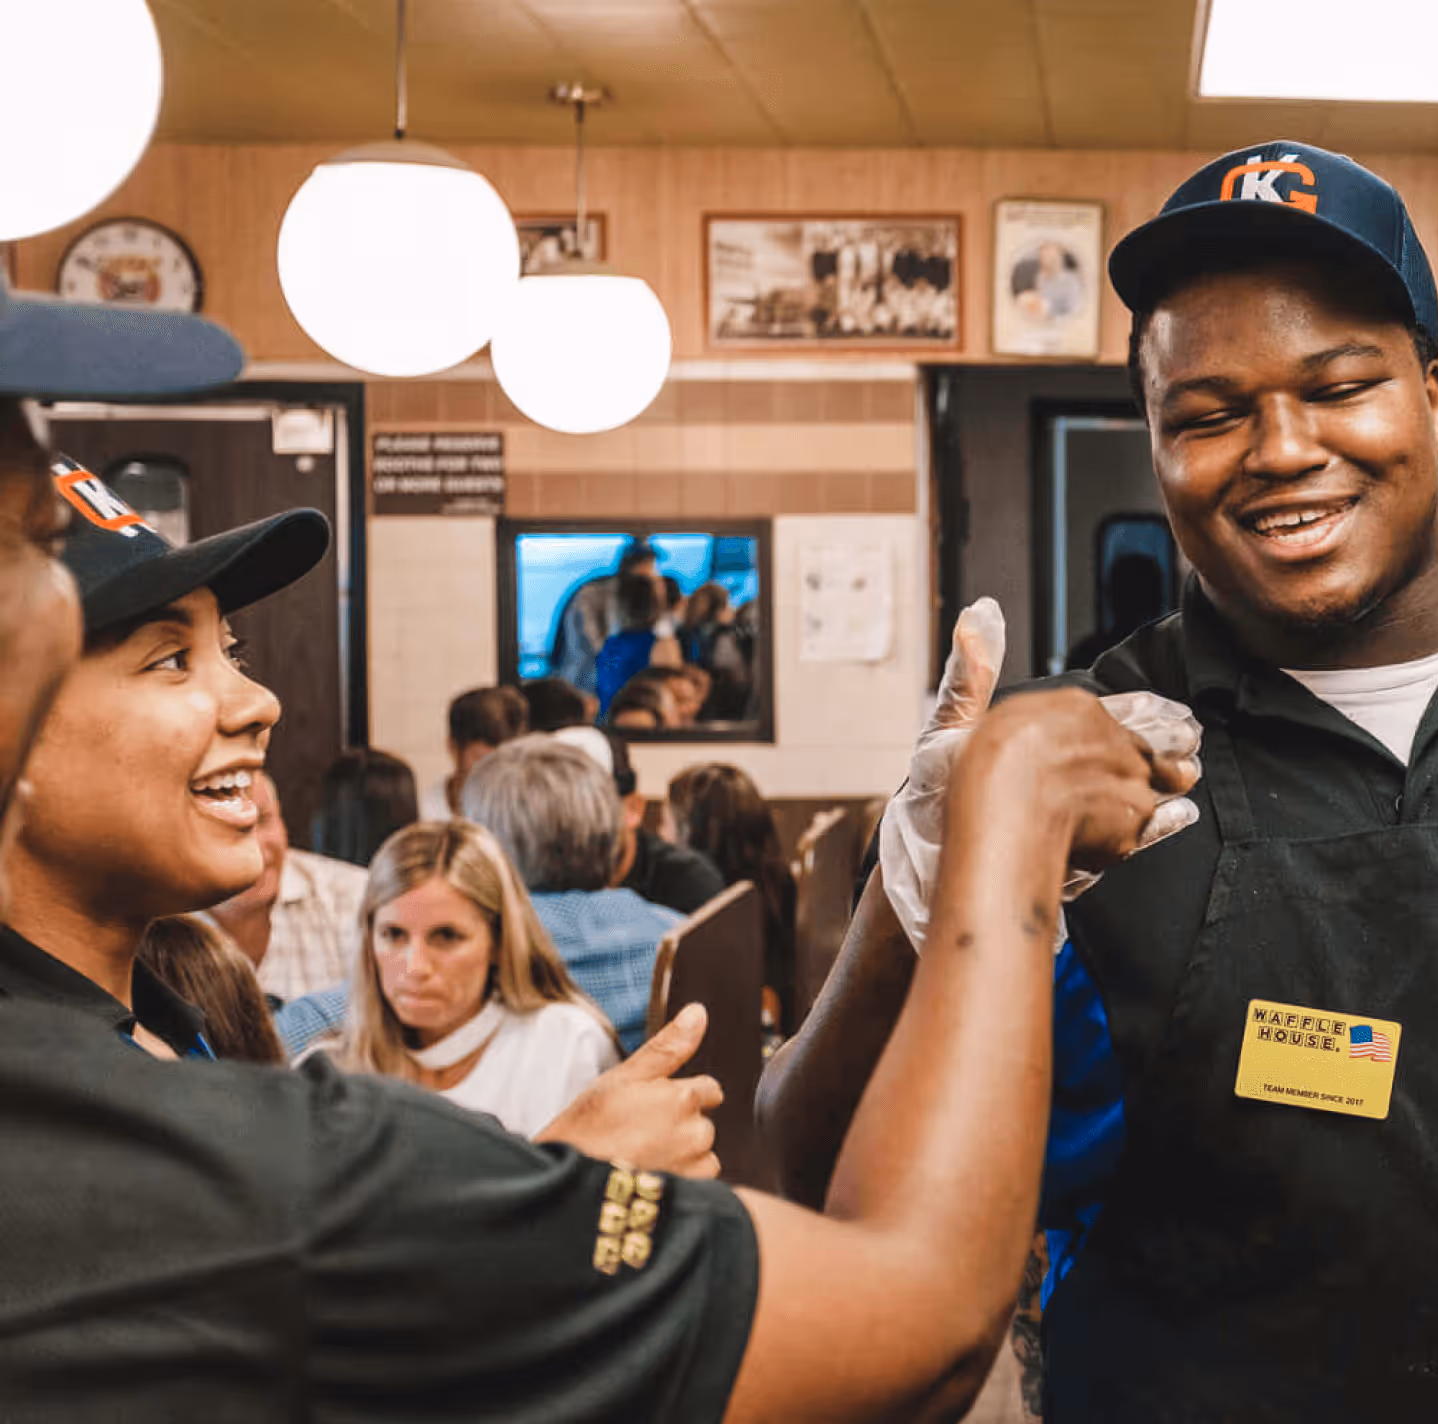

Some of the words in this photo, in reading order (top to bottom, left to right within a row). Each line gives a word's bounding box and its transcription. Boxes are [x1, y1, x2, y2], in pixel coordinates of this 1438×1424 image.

[1254, 1007, 1346, 1036] WAFFLE
[1263, 1083, 1285, 1095] TEAM
[1285, 1087, 1319, 1100] MEMBER
[1320, 1092, 1344, 1104] SINCE
